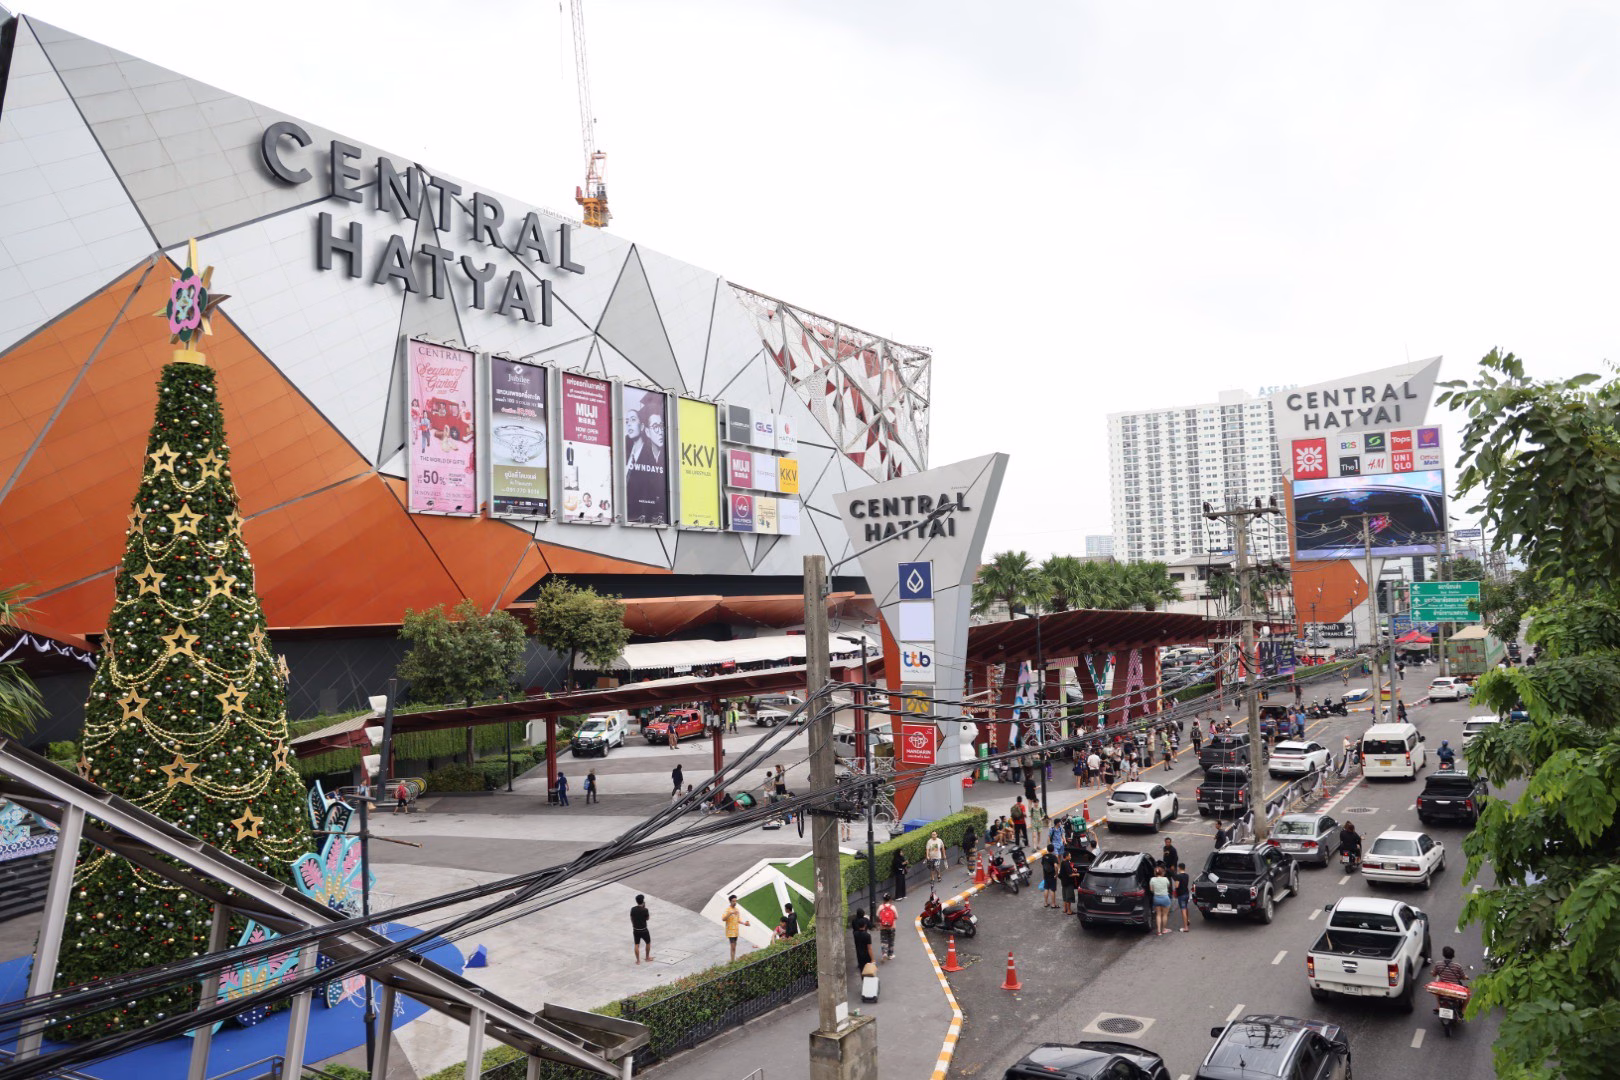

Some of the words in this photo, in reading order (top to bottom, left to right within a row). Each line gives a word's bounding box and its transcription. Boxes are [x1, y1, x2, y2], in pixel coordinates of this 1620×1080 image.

[261, 121, 585, 274] CENTRAL
[317, 211, 552, 327] HATYAI
[1286, 381, 1417, 411] CENTRAL
[576, 402, 598, 418] MUJI
[1304, 405, 1401, 431] HATYAI
[1391, 436, 1411, 444] Tops
[682, 442, 714, 468] KKV
[1394, 462, 1412, 470] QLO
[629, 464, 663, 474] OWNDAYS
[850, 492, 971, 519] CENTRAL
[865, 517, 956, 542] HATYAI
[1345, 625, 1353, 636] 2
[903, 651, 931, 668] ttb
